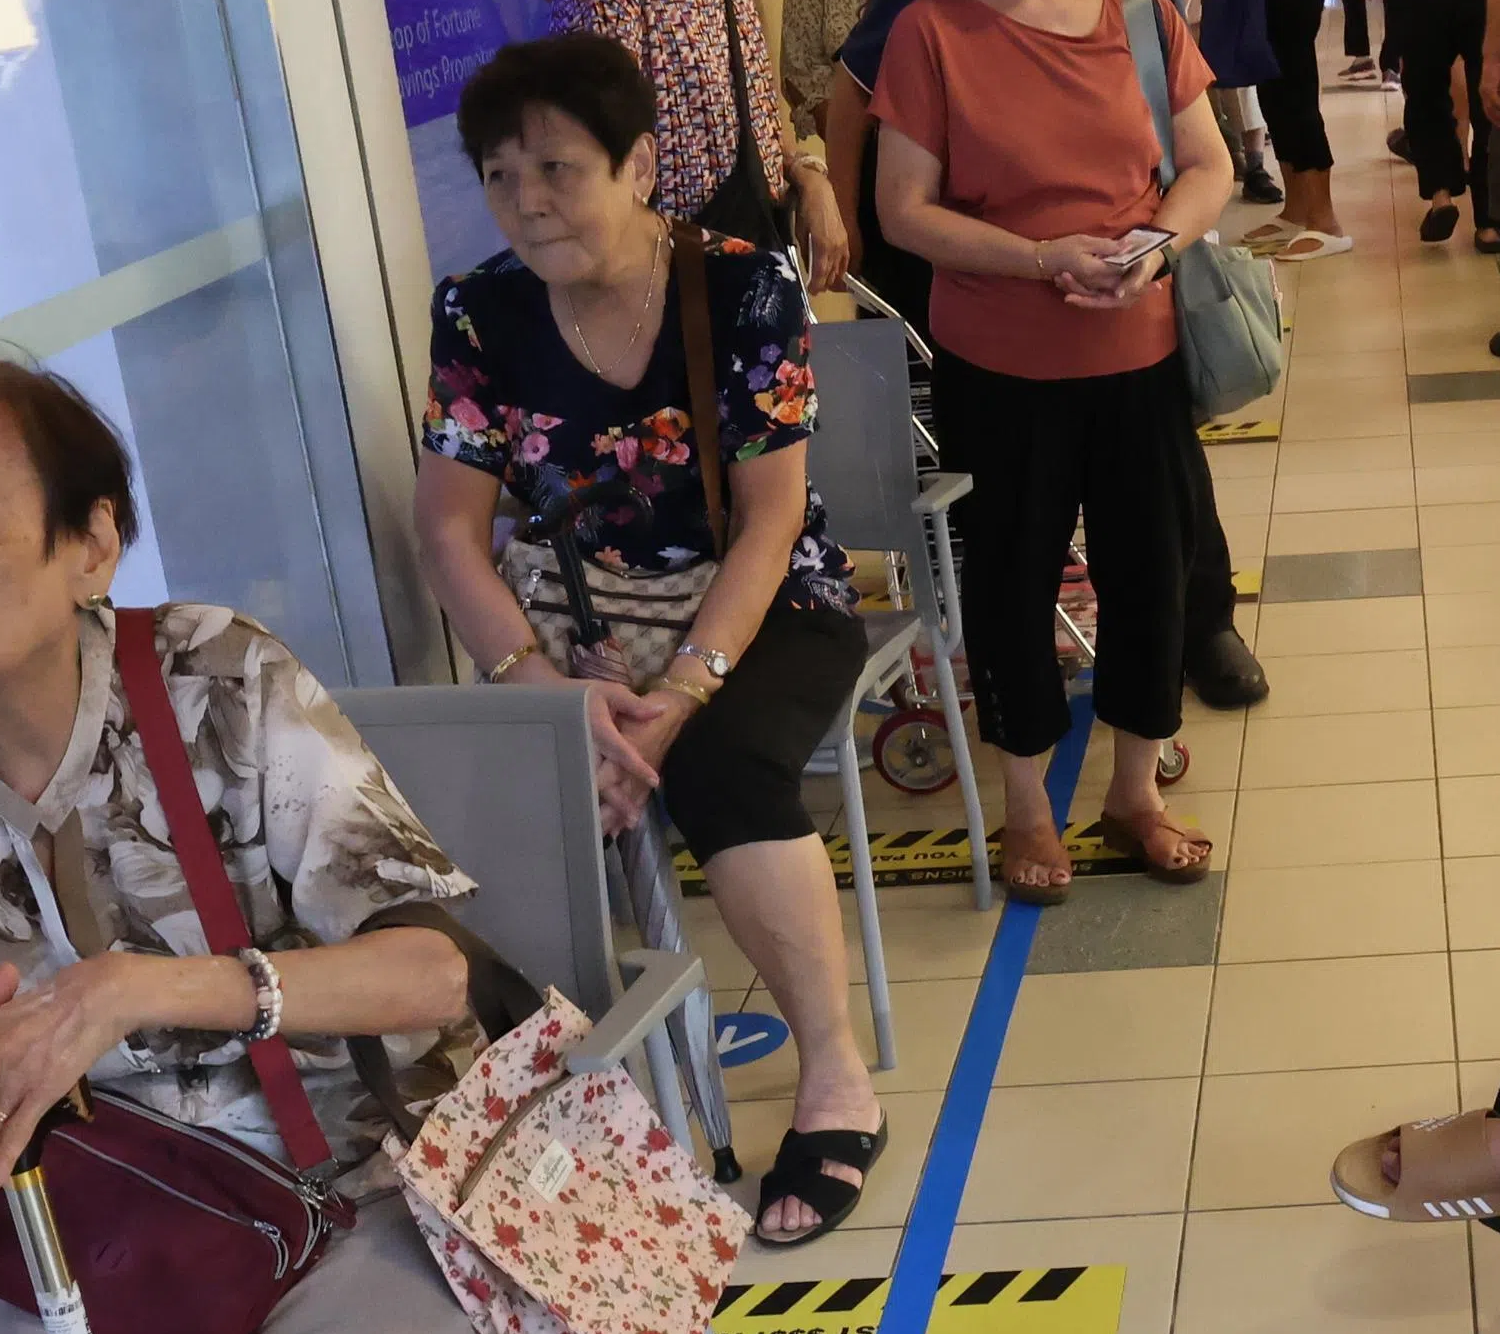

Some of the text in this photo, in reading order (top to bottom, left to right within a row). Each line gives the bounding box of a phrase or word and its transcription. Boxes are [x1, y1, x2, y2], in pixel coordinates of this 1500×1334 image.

[417, 9, 431, 44] of
[432, 7, 481, 38] Fortune
[913, 850, 959, 861] YOU
